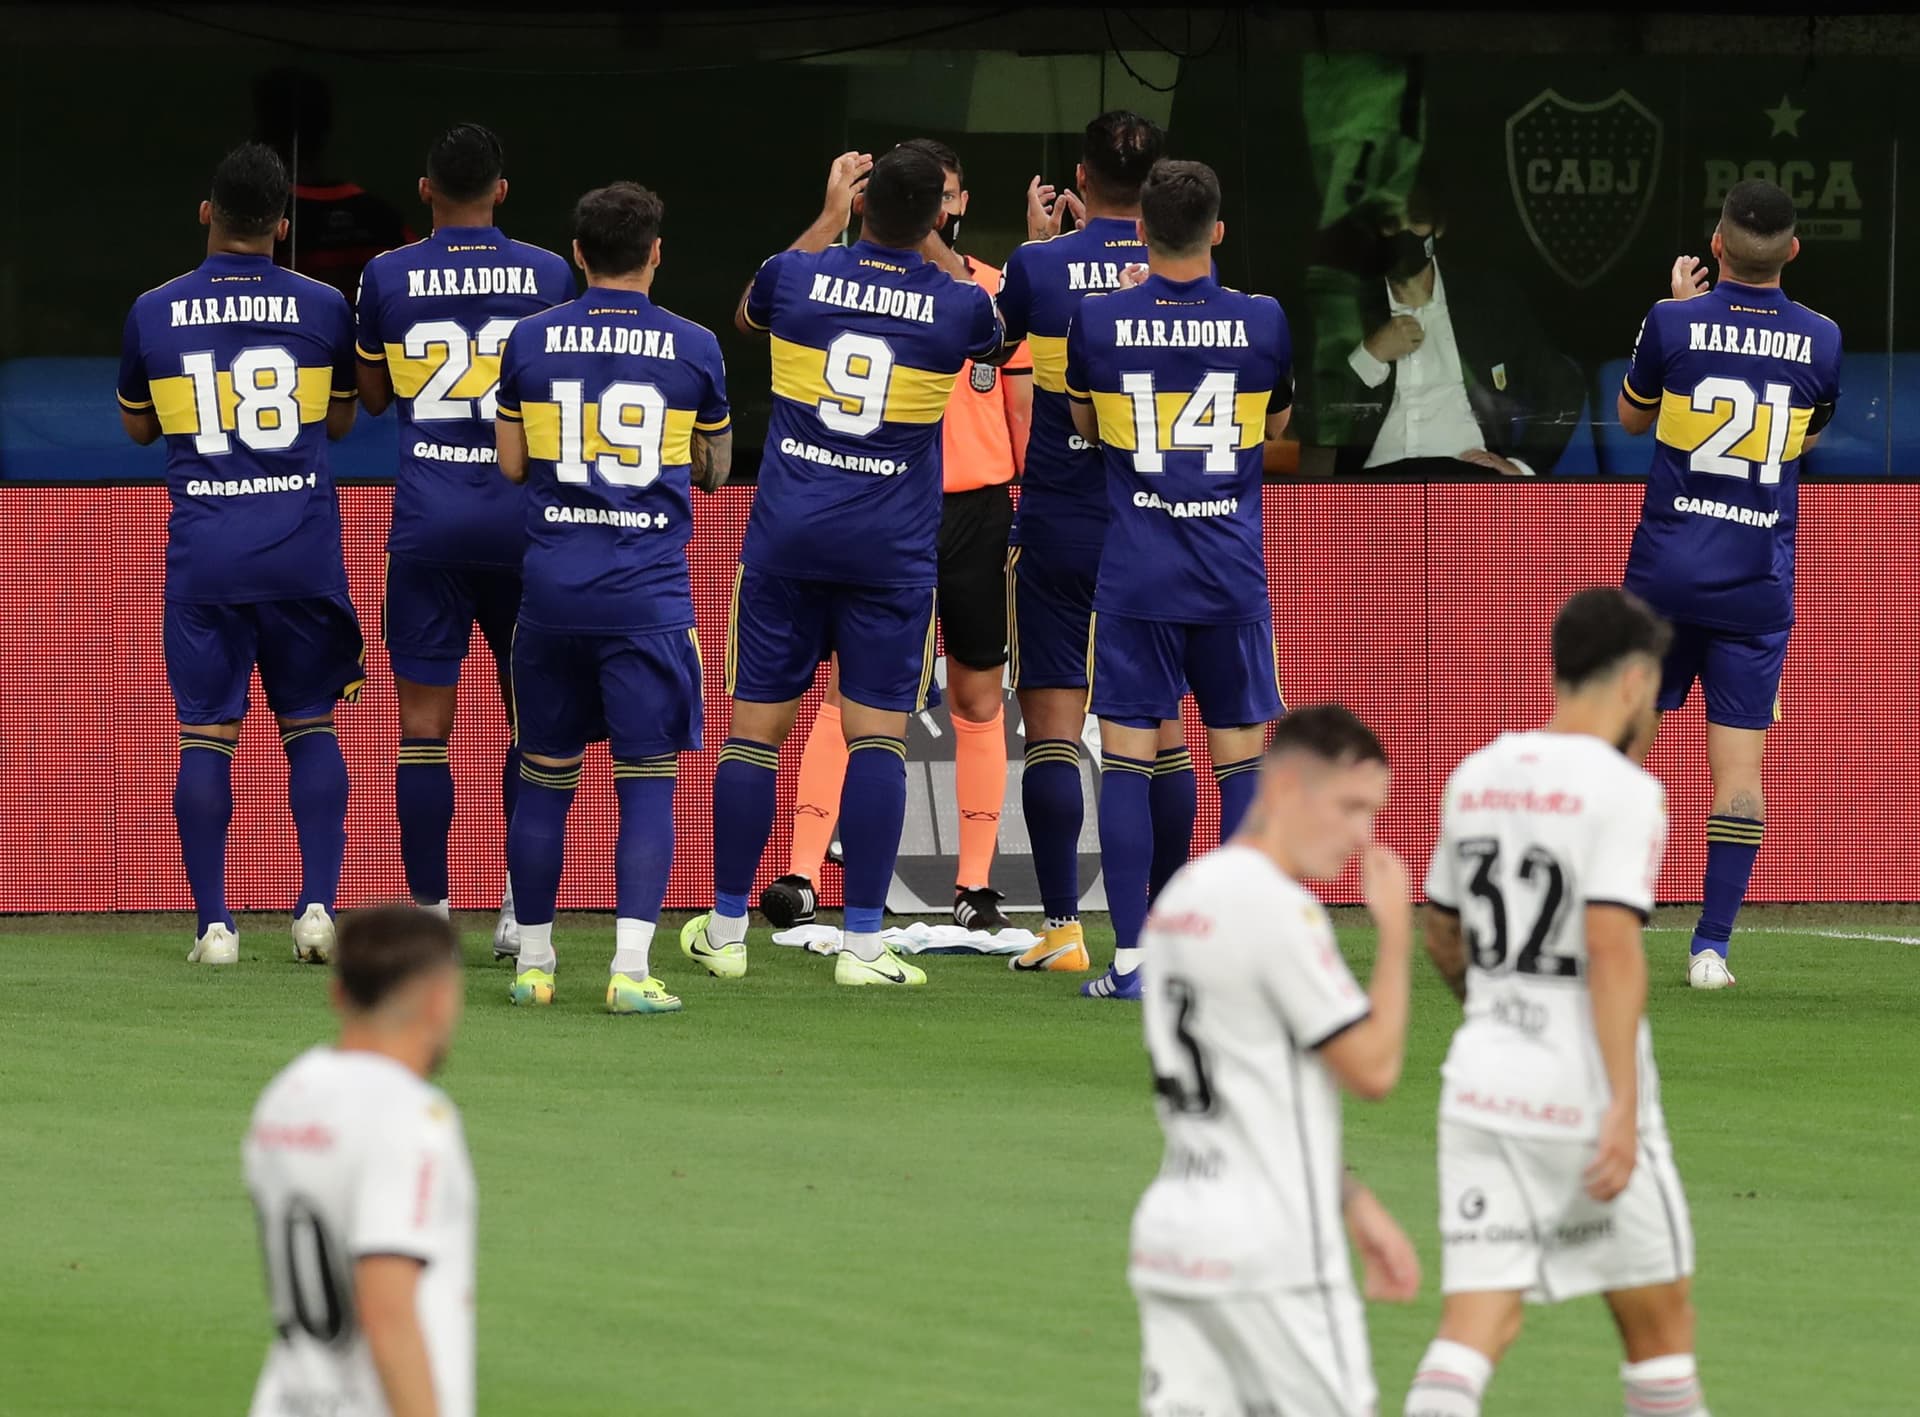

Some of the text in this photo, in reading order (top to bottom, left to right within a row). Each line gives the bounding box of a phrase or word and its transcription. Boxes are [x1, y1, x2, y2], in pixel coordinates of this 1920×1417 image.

[1527, 158, 1641, 195] CABJ
[408, 267, 538, 297] MARADONA
[808, 273, 935, 323] MARADONA
[1067, 262, 1150, 290] MAR
[171, 296, 299, 327] MARADONA
[1115, 319, 1249, 347] MARADONA
[545, 326, 676, 360] MARADONA
[1689, 322, 1812, 364] MARADONA
[182, 348, 301, 455] 18
[819, 333, 893, 437] 9
[552, 381, 669, 487] 19
[1122, 373, 1242, 473] 14
[1689, 377, 1792, 485] 21
[1457, 838, 1580, 977] 32
